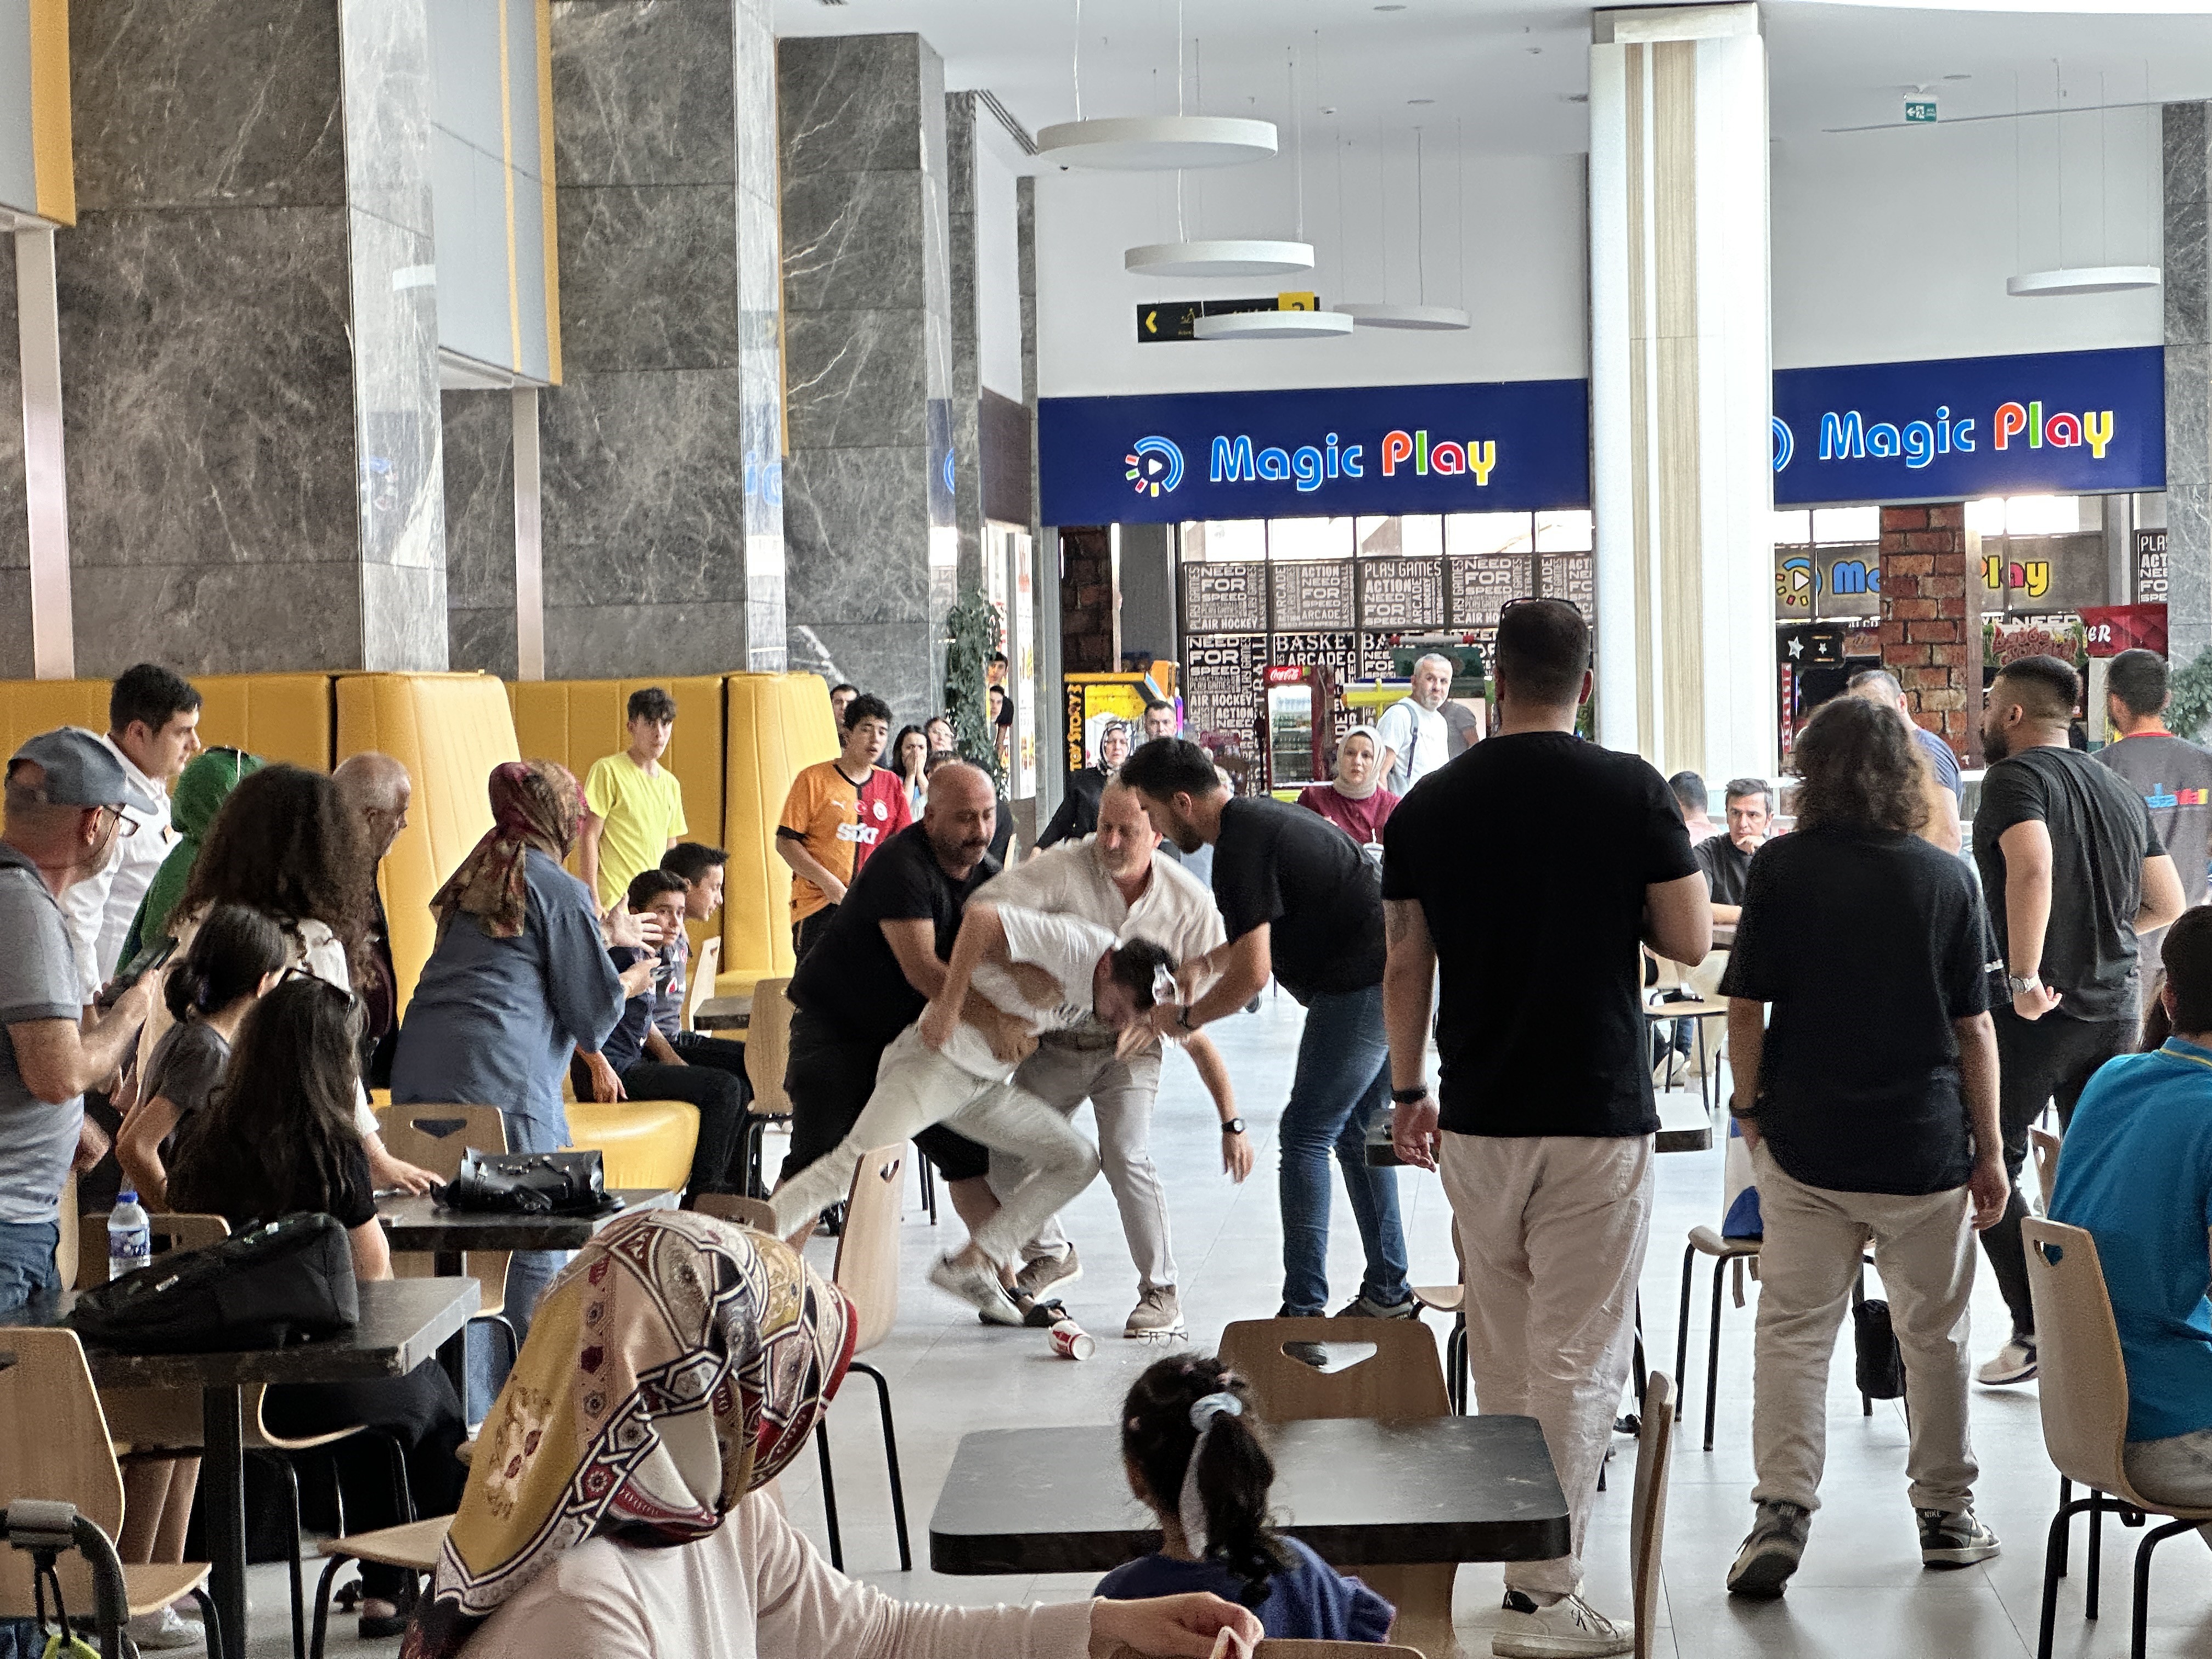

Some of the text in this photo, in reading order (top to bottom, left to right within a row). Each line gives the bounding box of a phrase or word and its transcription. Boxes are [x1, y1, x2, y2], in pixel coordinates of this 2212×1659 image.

[1819, 401, 2114, 469] Magic Play
[1210, 430, 1496, 492] Magic Play
[2141, 535, 2168, 551] PLA
[1465, 558, 1511, 570] NEED
[1569, 558, 1592, 571] ACT
[2141, 553, 2168, 568] ACT
[1201, 566, 1246, 577] NEED
[1302, 565, 1340, 577] ACTION
[1365, 561, 1441, 578] PLAY GAMES
[1981, 555, 2049, 597] lay
[2141, 568, 2168, 578] NEE
[1302, 577, 1340, 587] NEED
[1465, 571, 1511, 585] FOR
[1201, 578, 1246, 592] FOR
[1276, 566, 1287, 615] ARCADE
[1365, 578, 1412, 593] ACTION
[1465, 585, 1513, 596] SPEED
[1570, 580, 1592, 593] FO
[2141, 580, 2168, 593] FO
[1201, 592, 1247, 602] SPEED
[1302, 588, 1340, 599] FOR
[1341, 565, 1350, 628] BASKETBALL
[1364, 592, 1405, 603] NEED
[1453, 560, 1465, 624] PLAY GAMES
[2141, 593, 2168, 602] SPE
[1303, 600, 1341, 608] SPEED
[1412, 577, 1423, 625] ARCADE
[1302, 609, 1340, 620] ARCADE
[1364, 603, 1405, 617] FOR
[1189, 604, 1201, 630] PLAY
[1465, 612, 1483, 624] AIR
[1201, 618, 1258, 630] AIR HOCKEY
[1189, 637, 1240, 648] NEED
[1190, 650, 1239, 665] FOR
[1288, 651, 1346, 666] ARCADE
[1190, 665, 1241, 676] SPEED
[1190, 692, 1252, 707] AIR HOCKEY
[1216, 707, 1254, 719] ACTION
